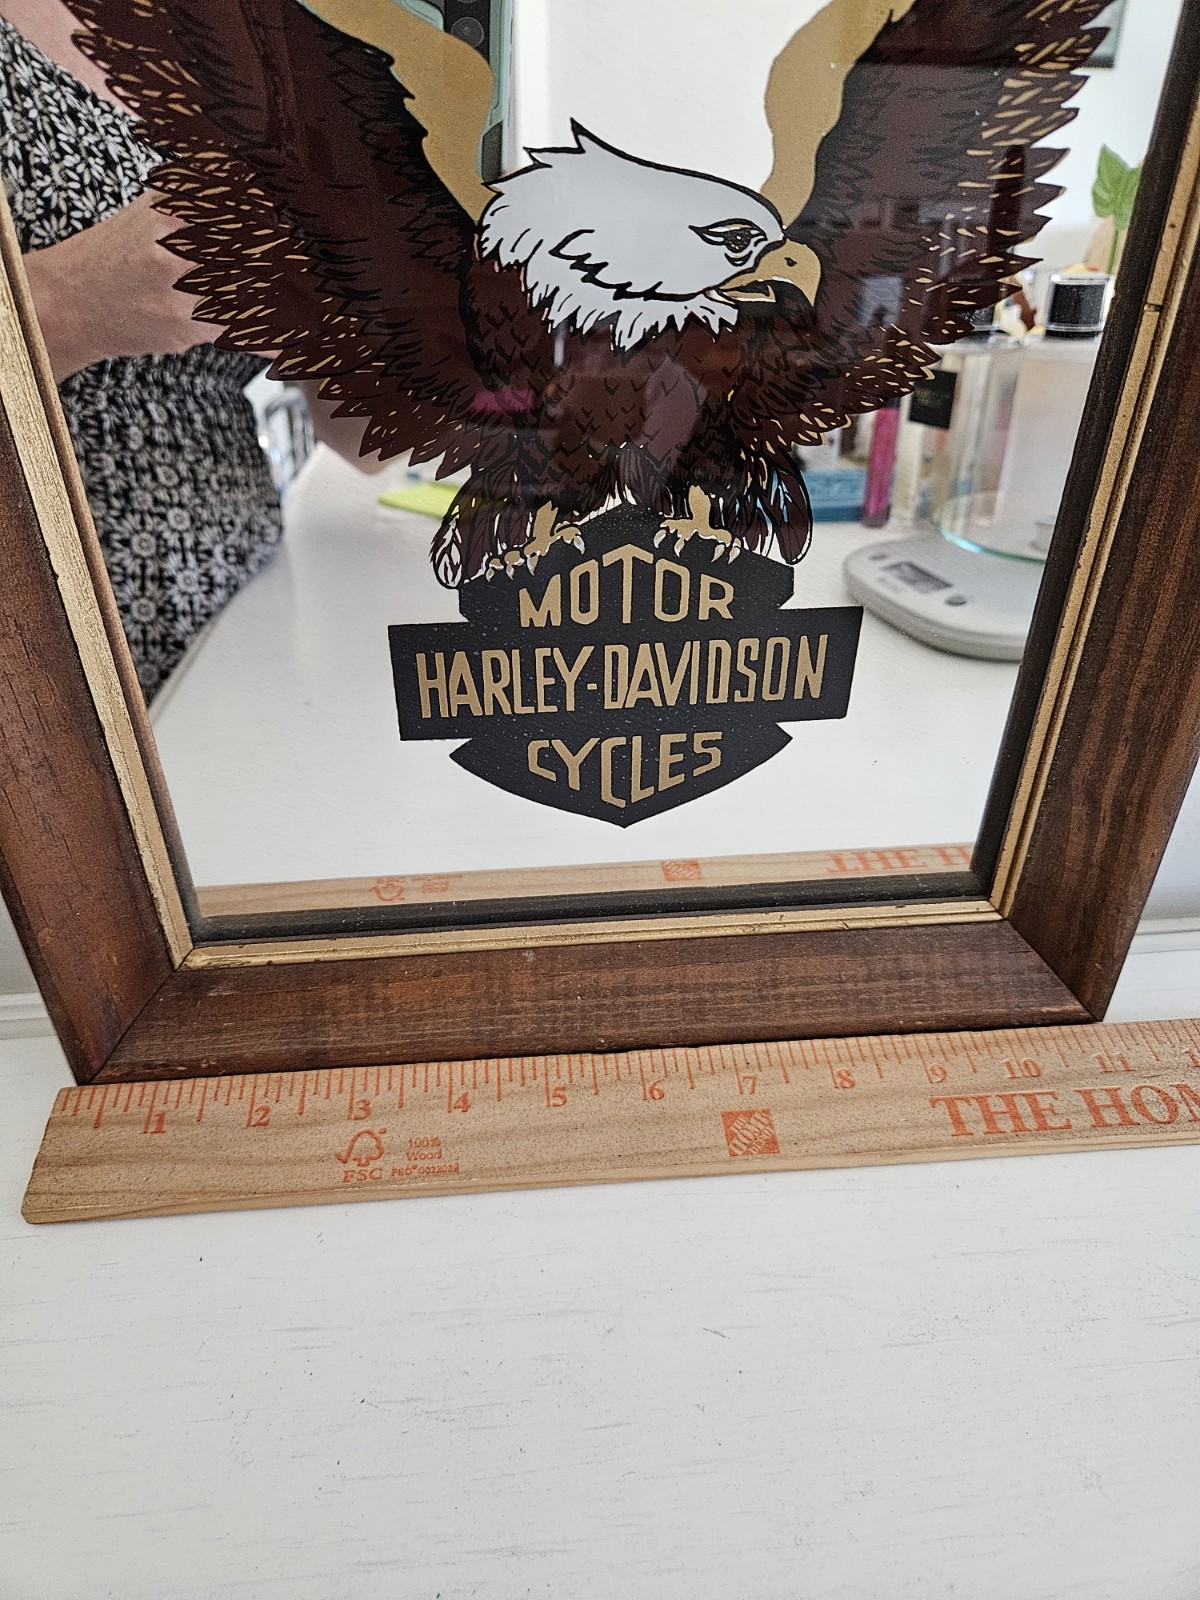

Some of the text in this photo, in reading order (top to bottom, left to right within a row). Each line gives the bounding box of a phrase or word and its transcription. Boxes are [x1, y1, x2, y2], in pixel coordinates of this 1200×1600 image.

[519, 543, 735, 628] MOTOR
[416, 633, 829, 719] HARLEY-DAVIDSON
[527, 731, 723, 809] CYCLES
[151, 1112, 167, 1134] 1
[252, 1105, 271, 1127] 2
[353, 1099, 372, 1121] 3
[453, 1091, 471, 1113] 4
[552, 1085, 569, 1107] 5
[649, 1079, 666, 1100] 6
[742, 1074, 758, 1095] 7
[836, 1068, 856, 1089] 8
[929, 1063, 948, 1083] 9
[1001, 1057, 1042, 1079] 10
[1094, 1052, 1136, 1073] 11
[929, 1090, 1073, 1137] THE
[405, 1149, 442, 1161] Wood
[408, 1136, 442, 1148] 100%
[343, 1168, 383, 1183] FSC
